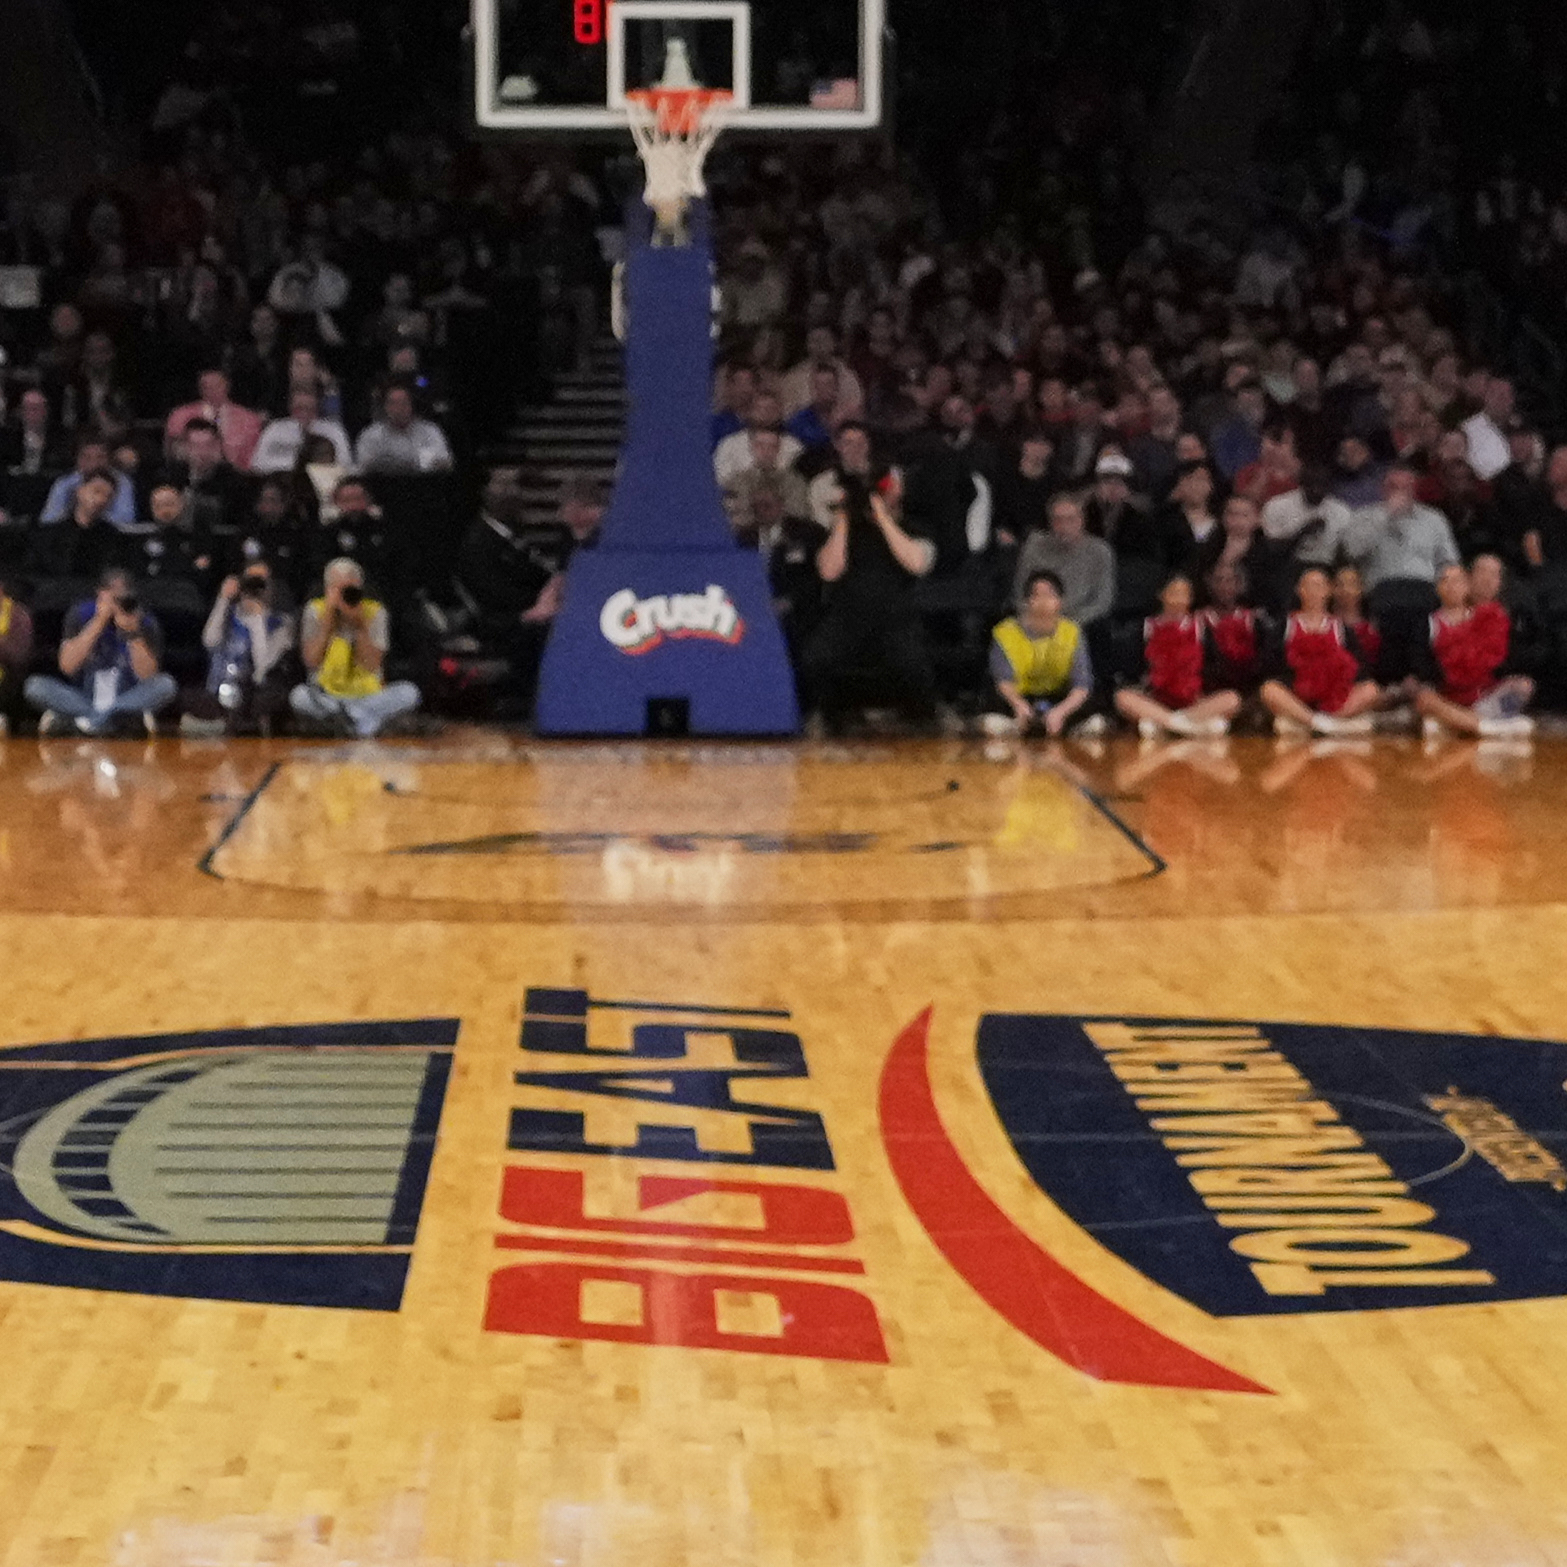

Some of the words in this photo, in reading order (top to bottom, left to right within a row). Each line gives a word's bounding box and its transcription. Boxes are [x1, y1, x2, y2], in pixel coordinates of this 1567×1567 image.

[600, 584, 746, 656] Crush
[505, 985, 838, 1171] EAST
[1080, 1021, 1497, 1297] TOURNAMENT
[481, 1165, 891, 1364] BIG
